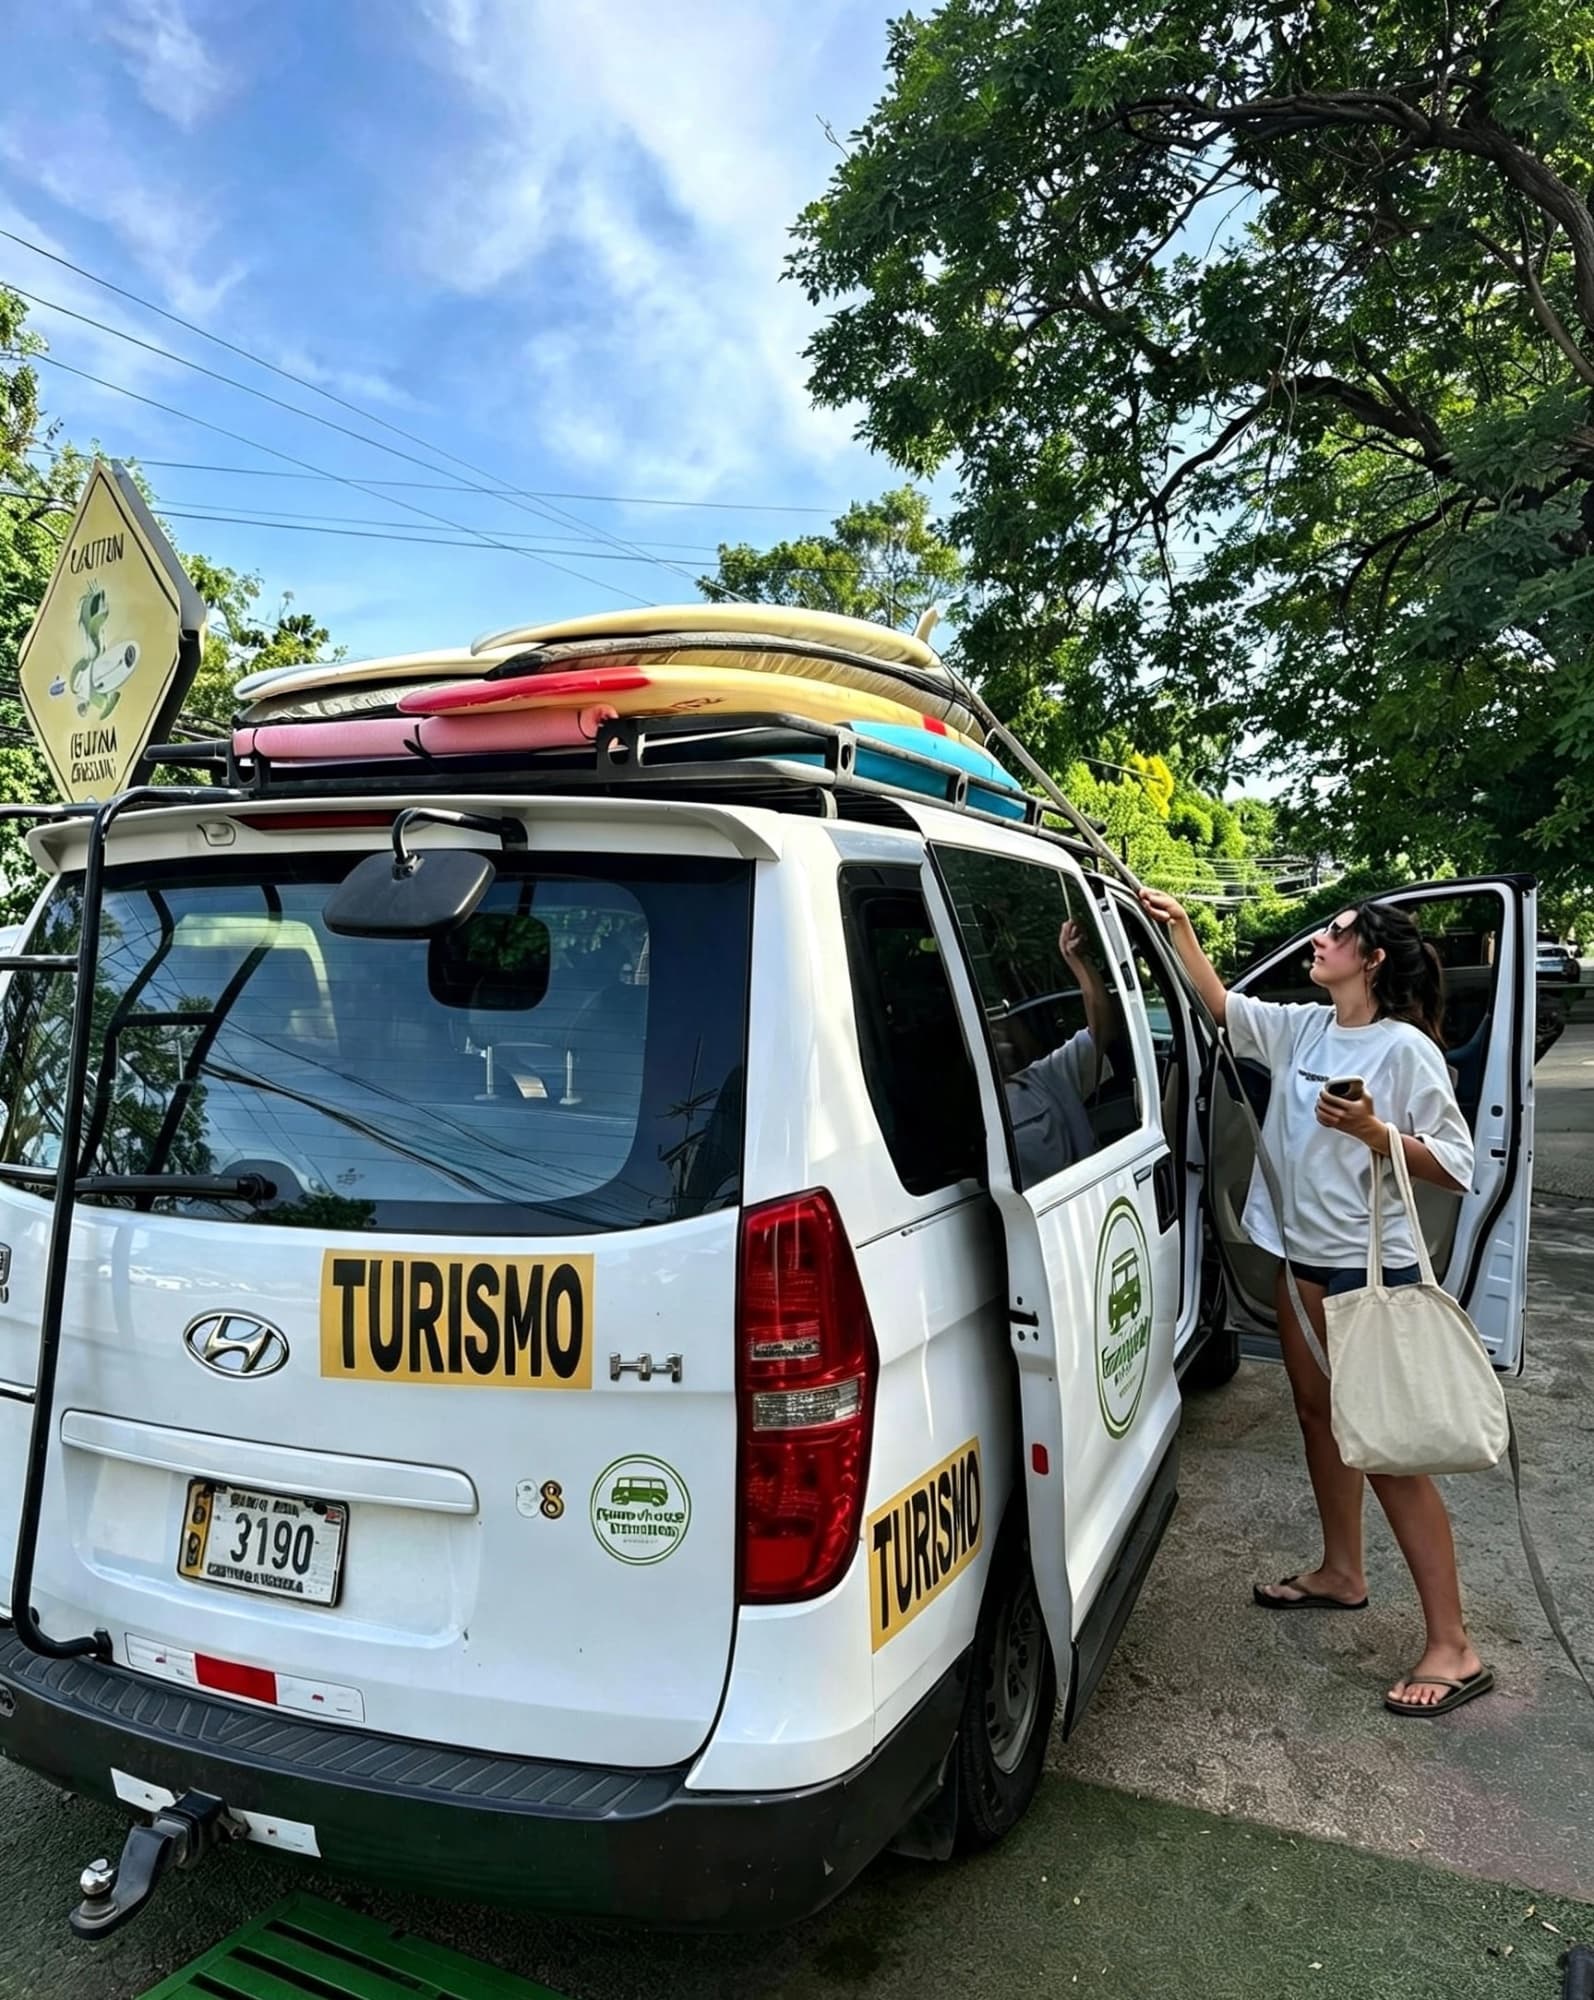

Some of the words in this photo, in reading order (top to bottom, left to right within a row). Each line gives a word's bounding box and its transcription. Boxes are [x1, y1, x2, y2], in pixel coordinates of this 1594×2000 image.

[333, 1259, 583, 1379] TURISMO
[230, 1513, 314, 1575] 3190
[873, 1450, 981, 1630] TURISMO
